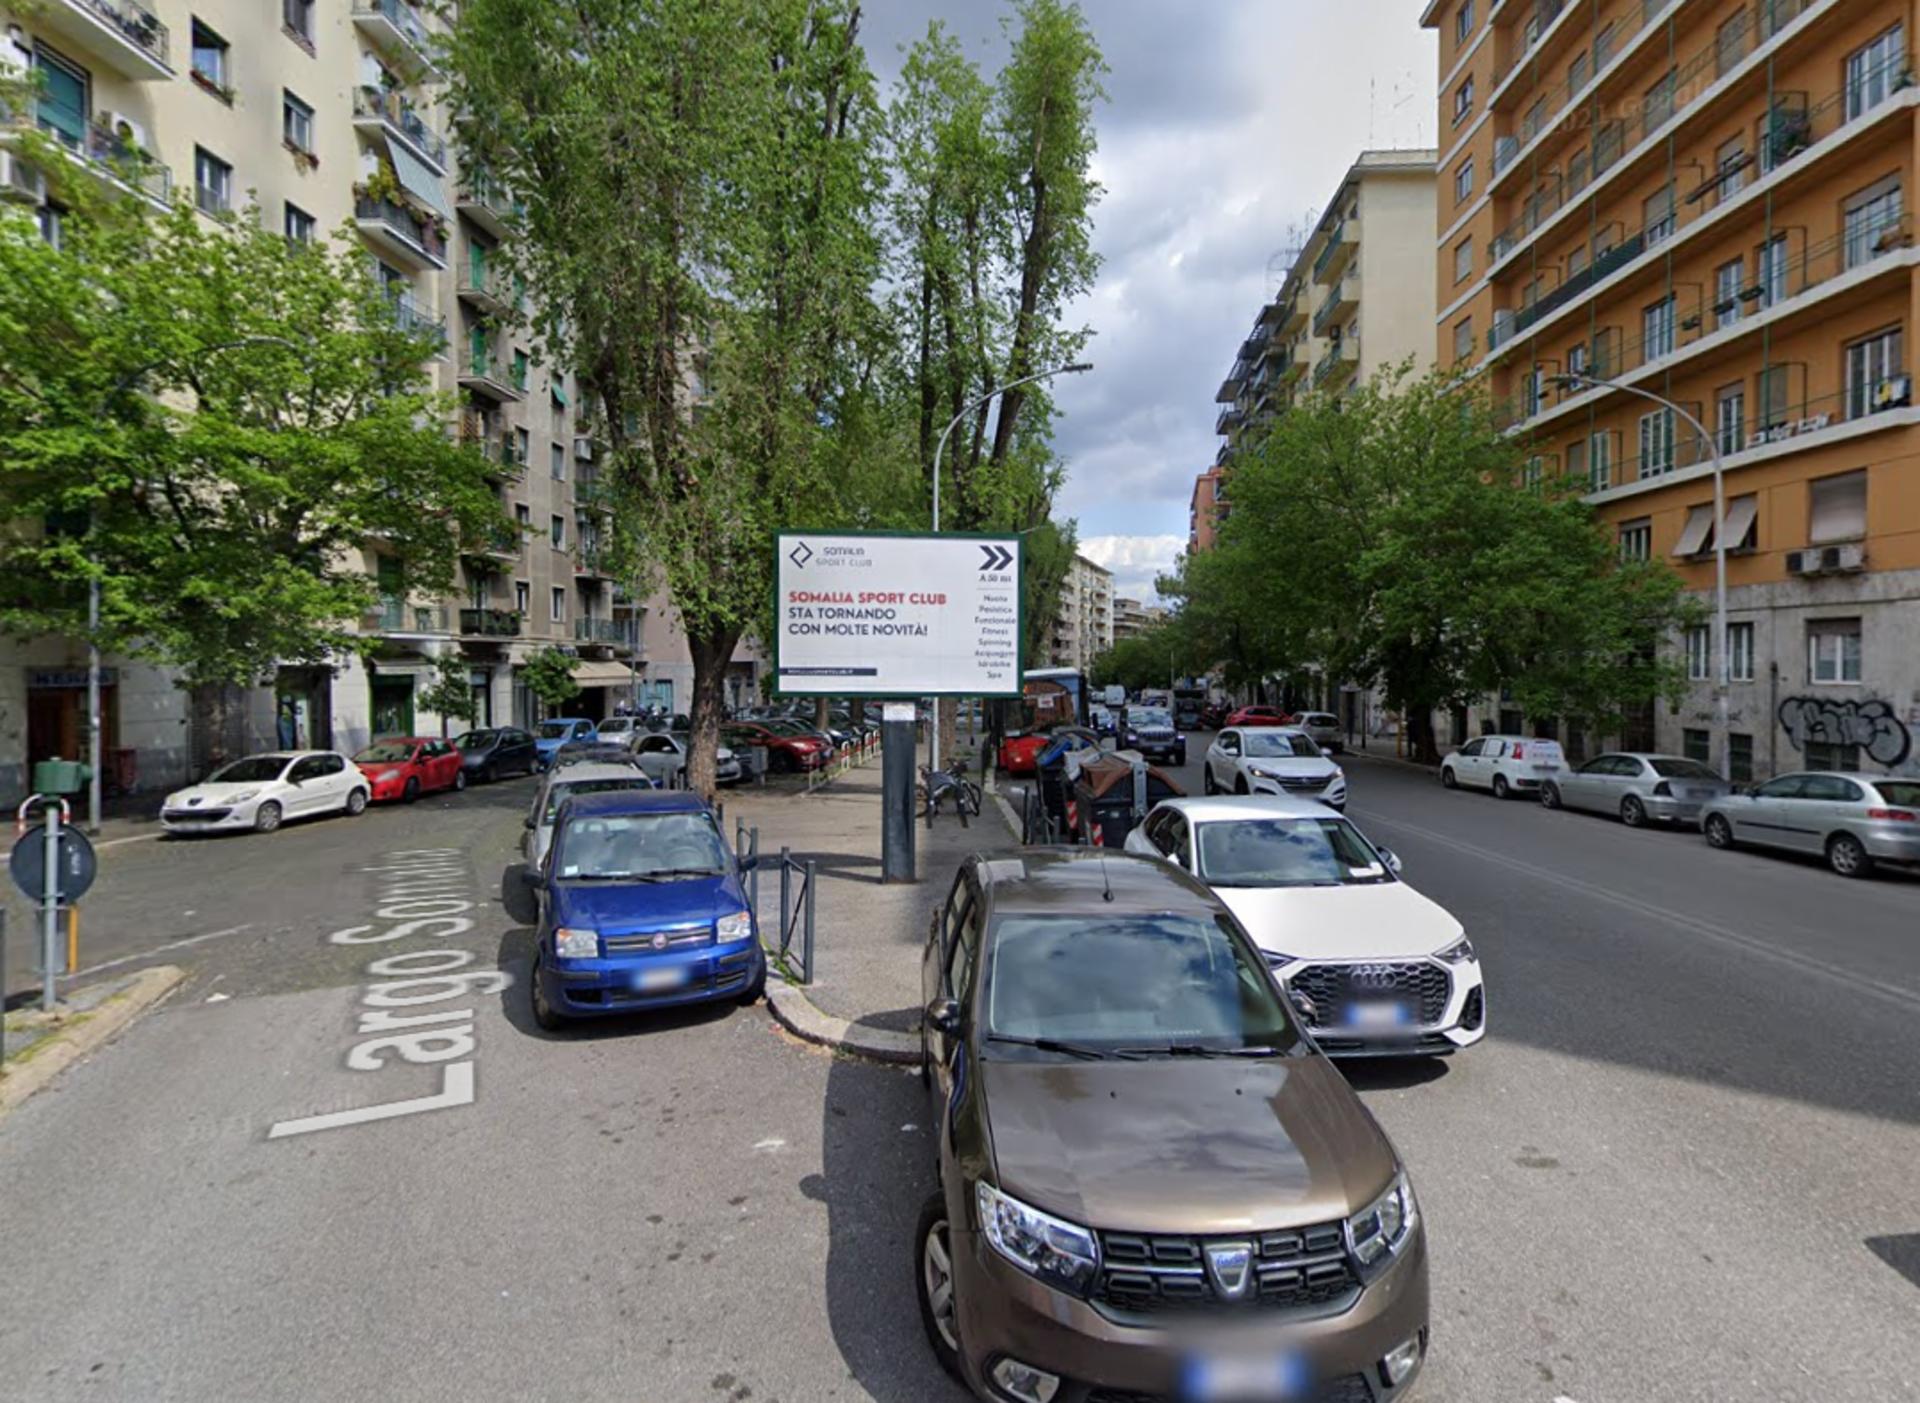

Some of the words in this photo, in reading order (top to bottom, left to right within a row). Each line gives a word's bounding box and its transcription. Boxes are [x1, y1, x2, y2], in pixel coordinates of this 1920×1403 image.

[849, 559, 873, 567] CLUB
[788, 592, 854, 604] SOMALIA
[858, 592, 905, 604] SPORT
[909, 593, 947, 605] CLUB
[788, 608, 813, 619] STA
[818, 608, 896, 620] TORNANDO
[788, 623, 821, 635] CON
[825, 624, 869, 635] MOLTE
[872, 622, 928, 636] NOVITÀ!
